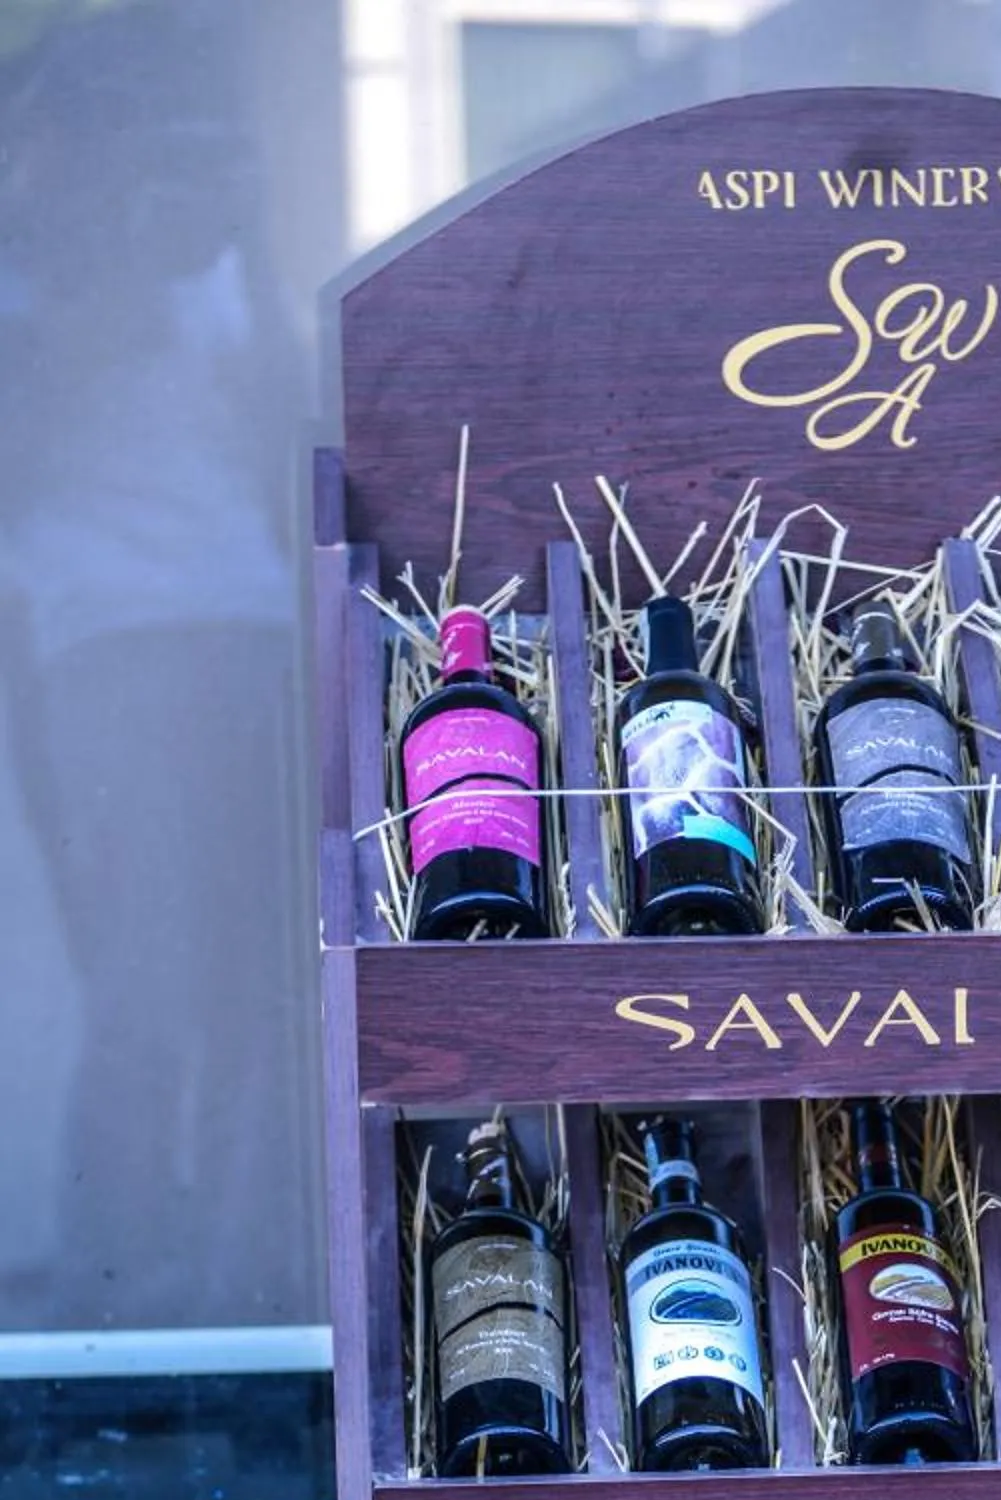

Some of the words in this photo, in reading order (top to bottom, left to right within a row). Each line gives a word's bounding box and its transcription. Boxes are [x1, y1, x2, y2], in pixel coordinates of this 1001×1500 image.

[697, 167, 796, 210] ASPI
[416, 745, 526, 776] SAVALAN
[446, 1273, 553, 1300] SAVALAN
